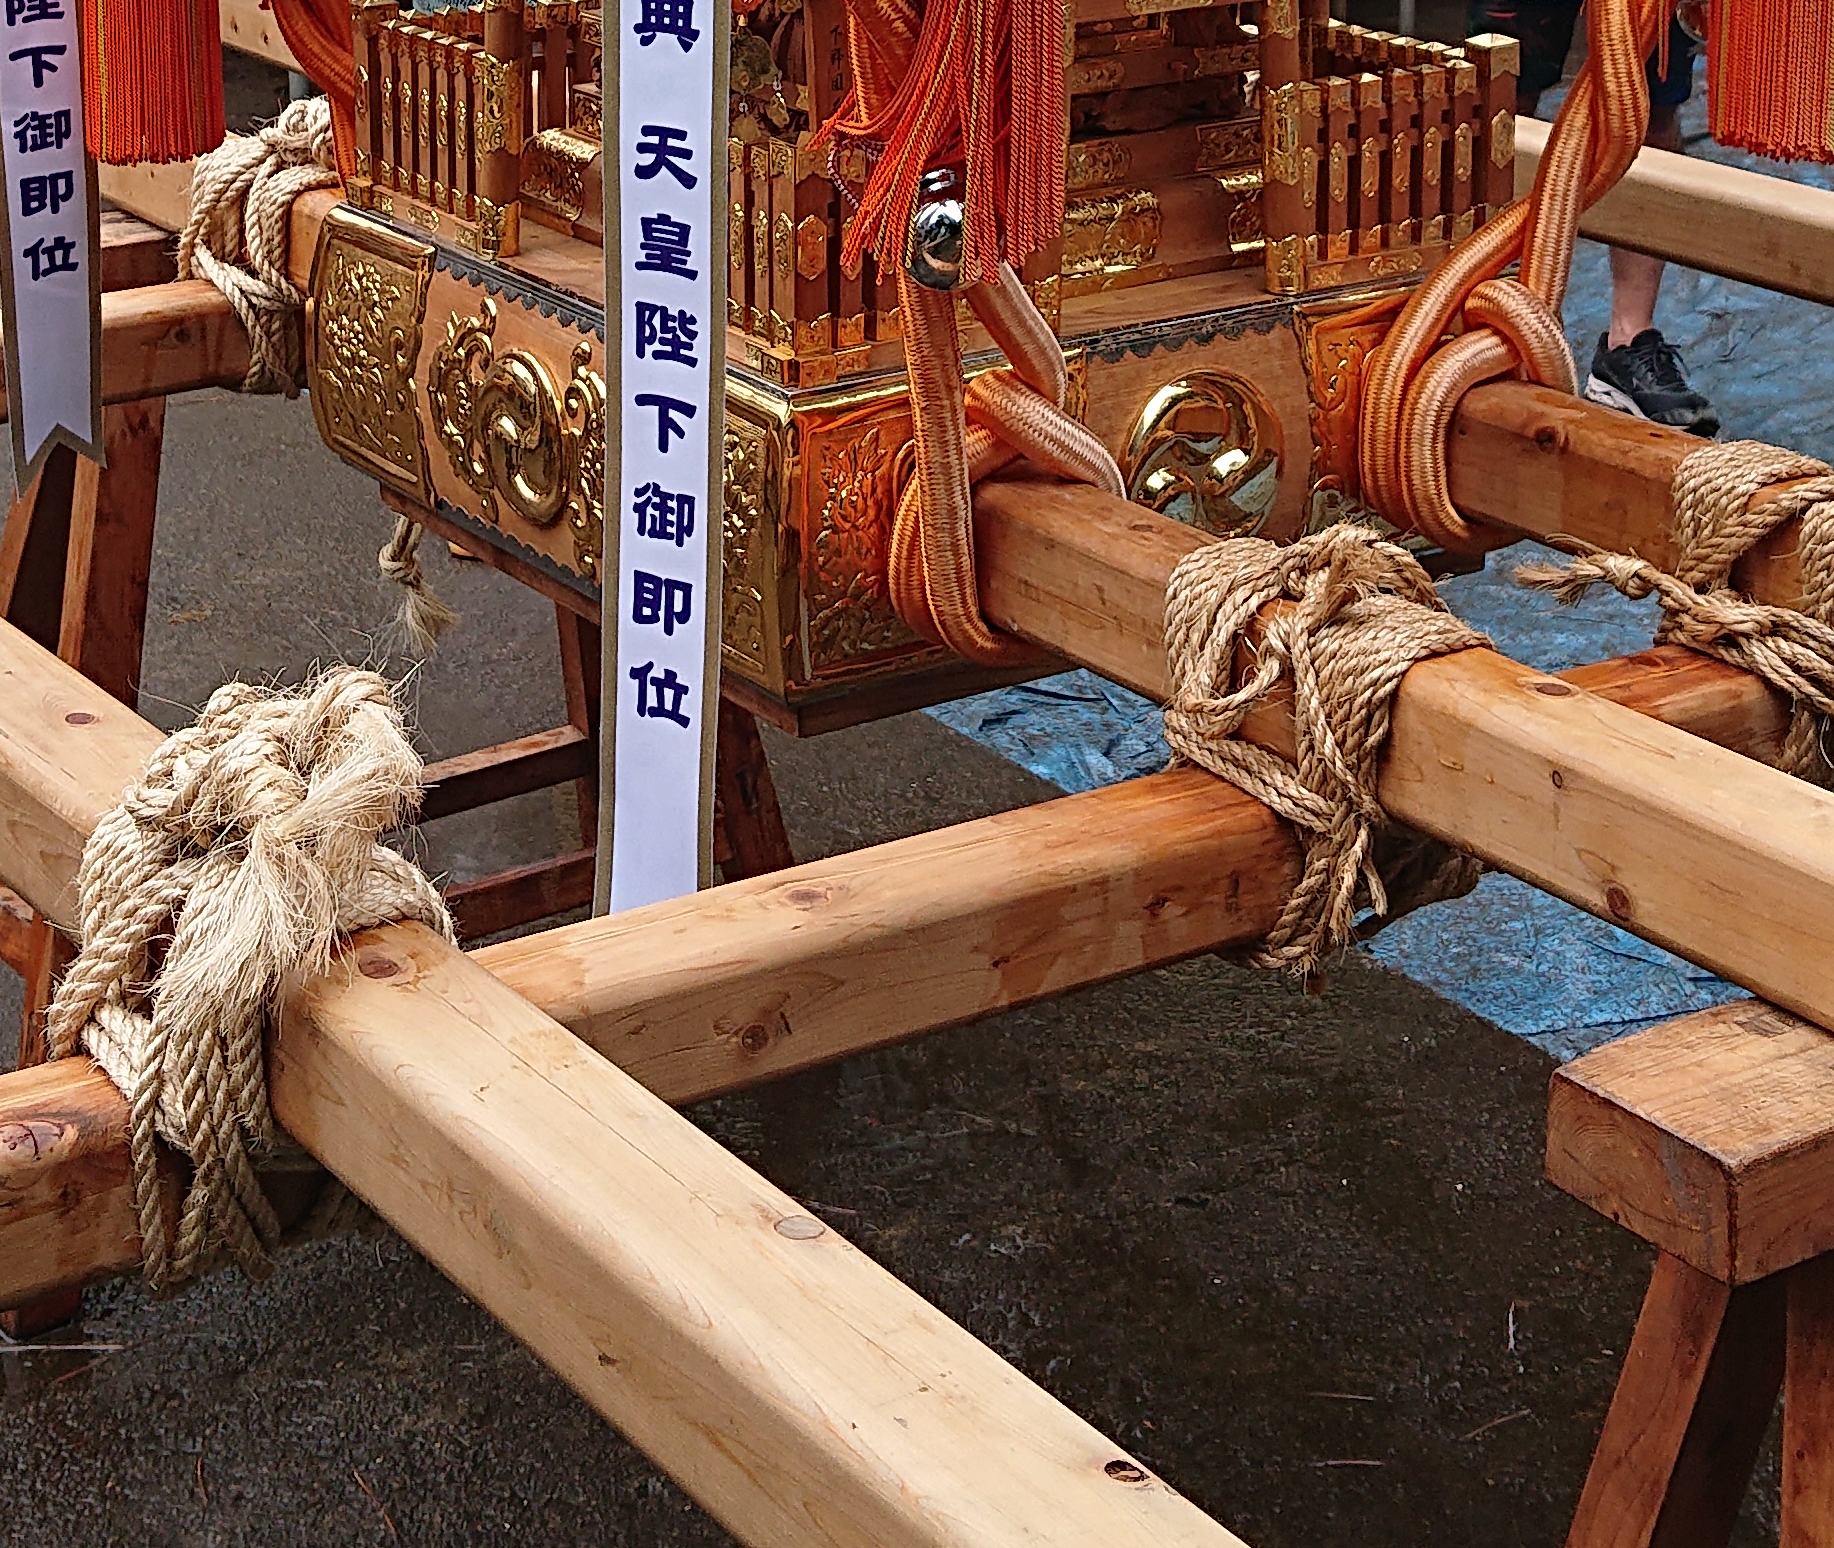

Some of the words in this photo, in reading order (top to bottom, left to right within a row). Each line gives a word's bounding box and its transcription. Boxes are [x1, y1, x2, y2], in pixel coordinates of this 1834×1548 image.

[629, 124, 699, 729] 天皇陛下御即位
